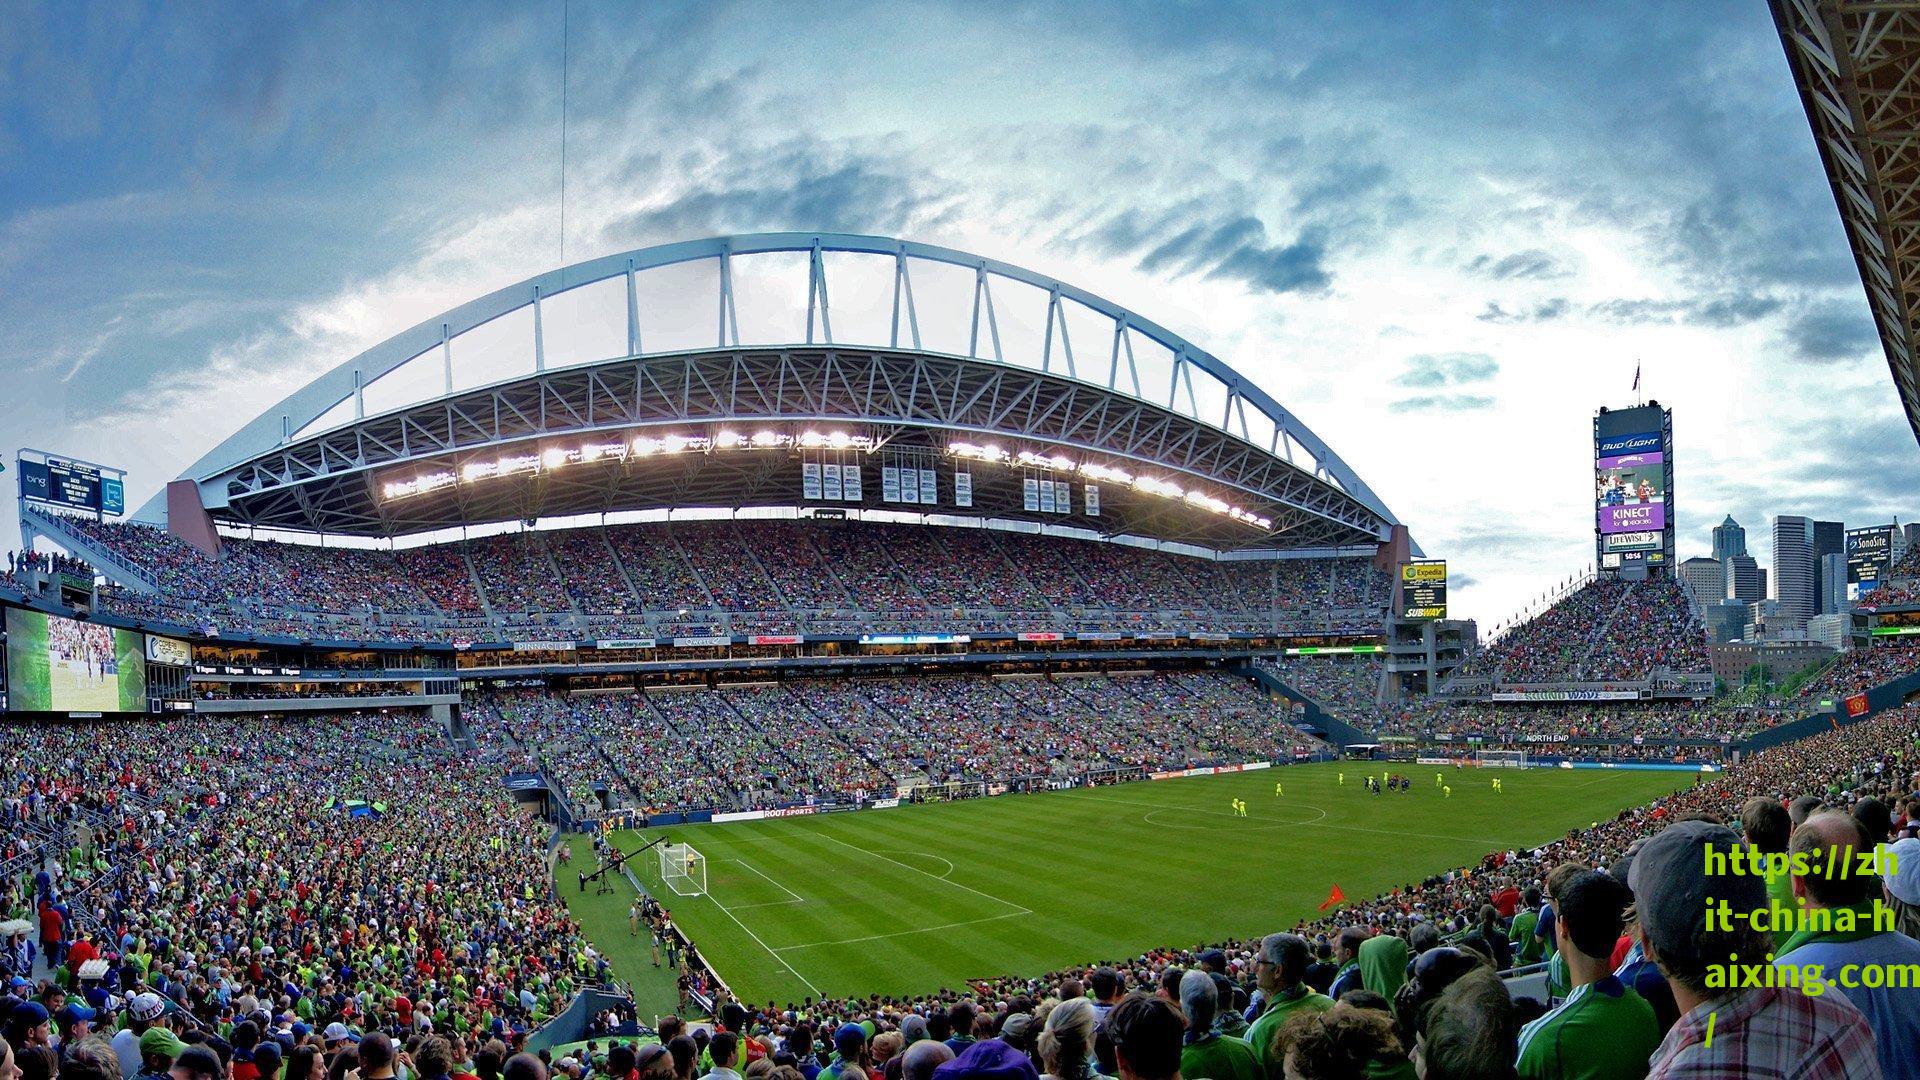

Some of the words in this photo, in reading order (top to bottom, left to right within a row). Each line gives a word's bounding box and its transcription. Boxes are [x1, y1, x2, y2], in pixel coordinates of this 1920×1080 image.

[1628, 438, 1659, 447] LIGHT
[26, 475, 46, 487] bing
[1613, 507, 1653, 519] KINECT
[1858, 536, 1887, 549] SonoSite
[1416, 569, 1442, 577] Expedia
[1405, 608, 1445, 617] SUBWAY
[518, 641, 567, 650] PINNACLE
[611, 640, 651, 650] walottery.com
[685, 637, 709, 646] Qwest
[1526, 734, 1552, 742] NORTH
[1553, 734, 1569, 742] END
[764, 809, 786, 818] ROOT
[787, 807, 814, 816] SPORTS
